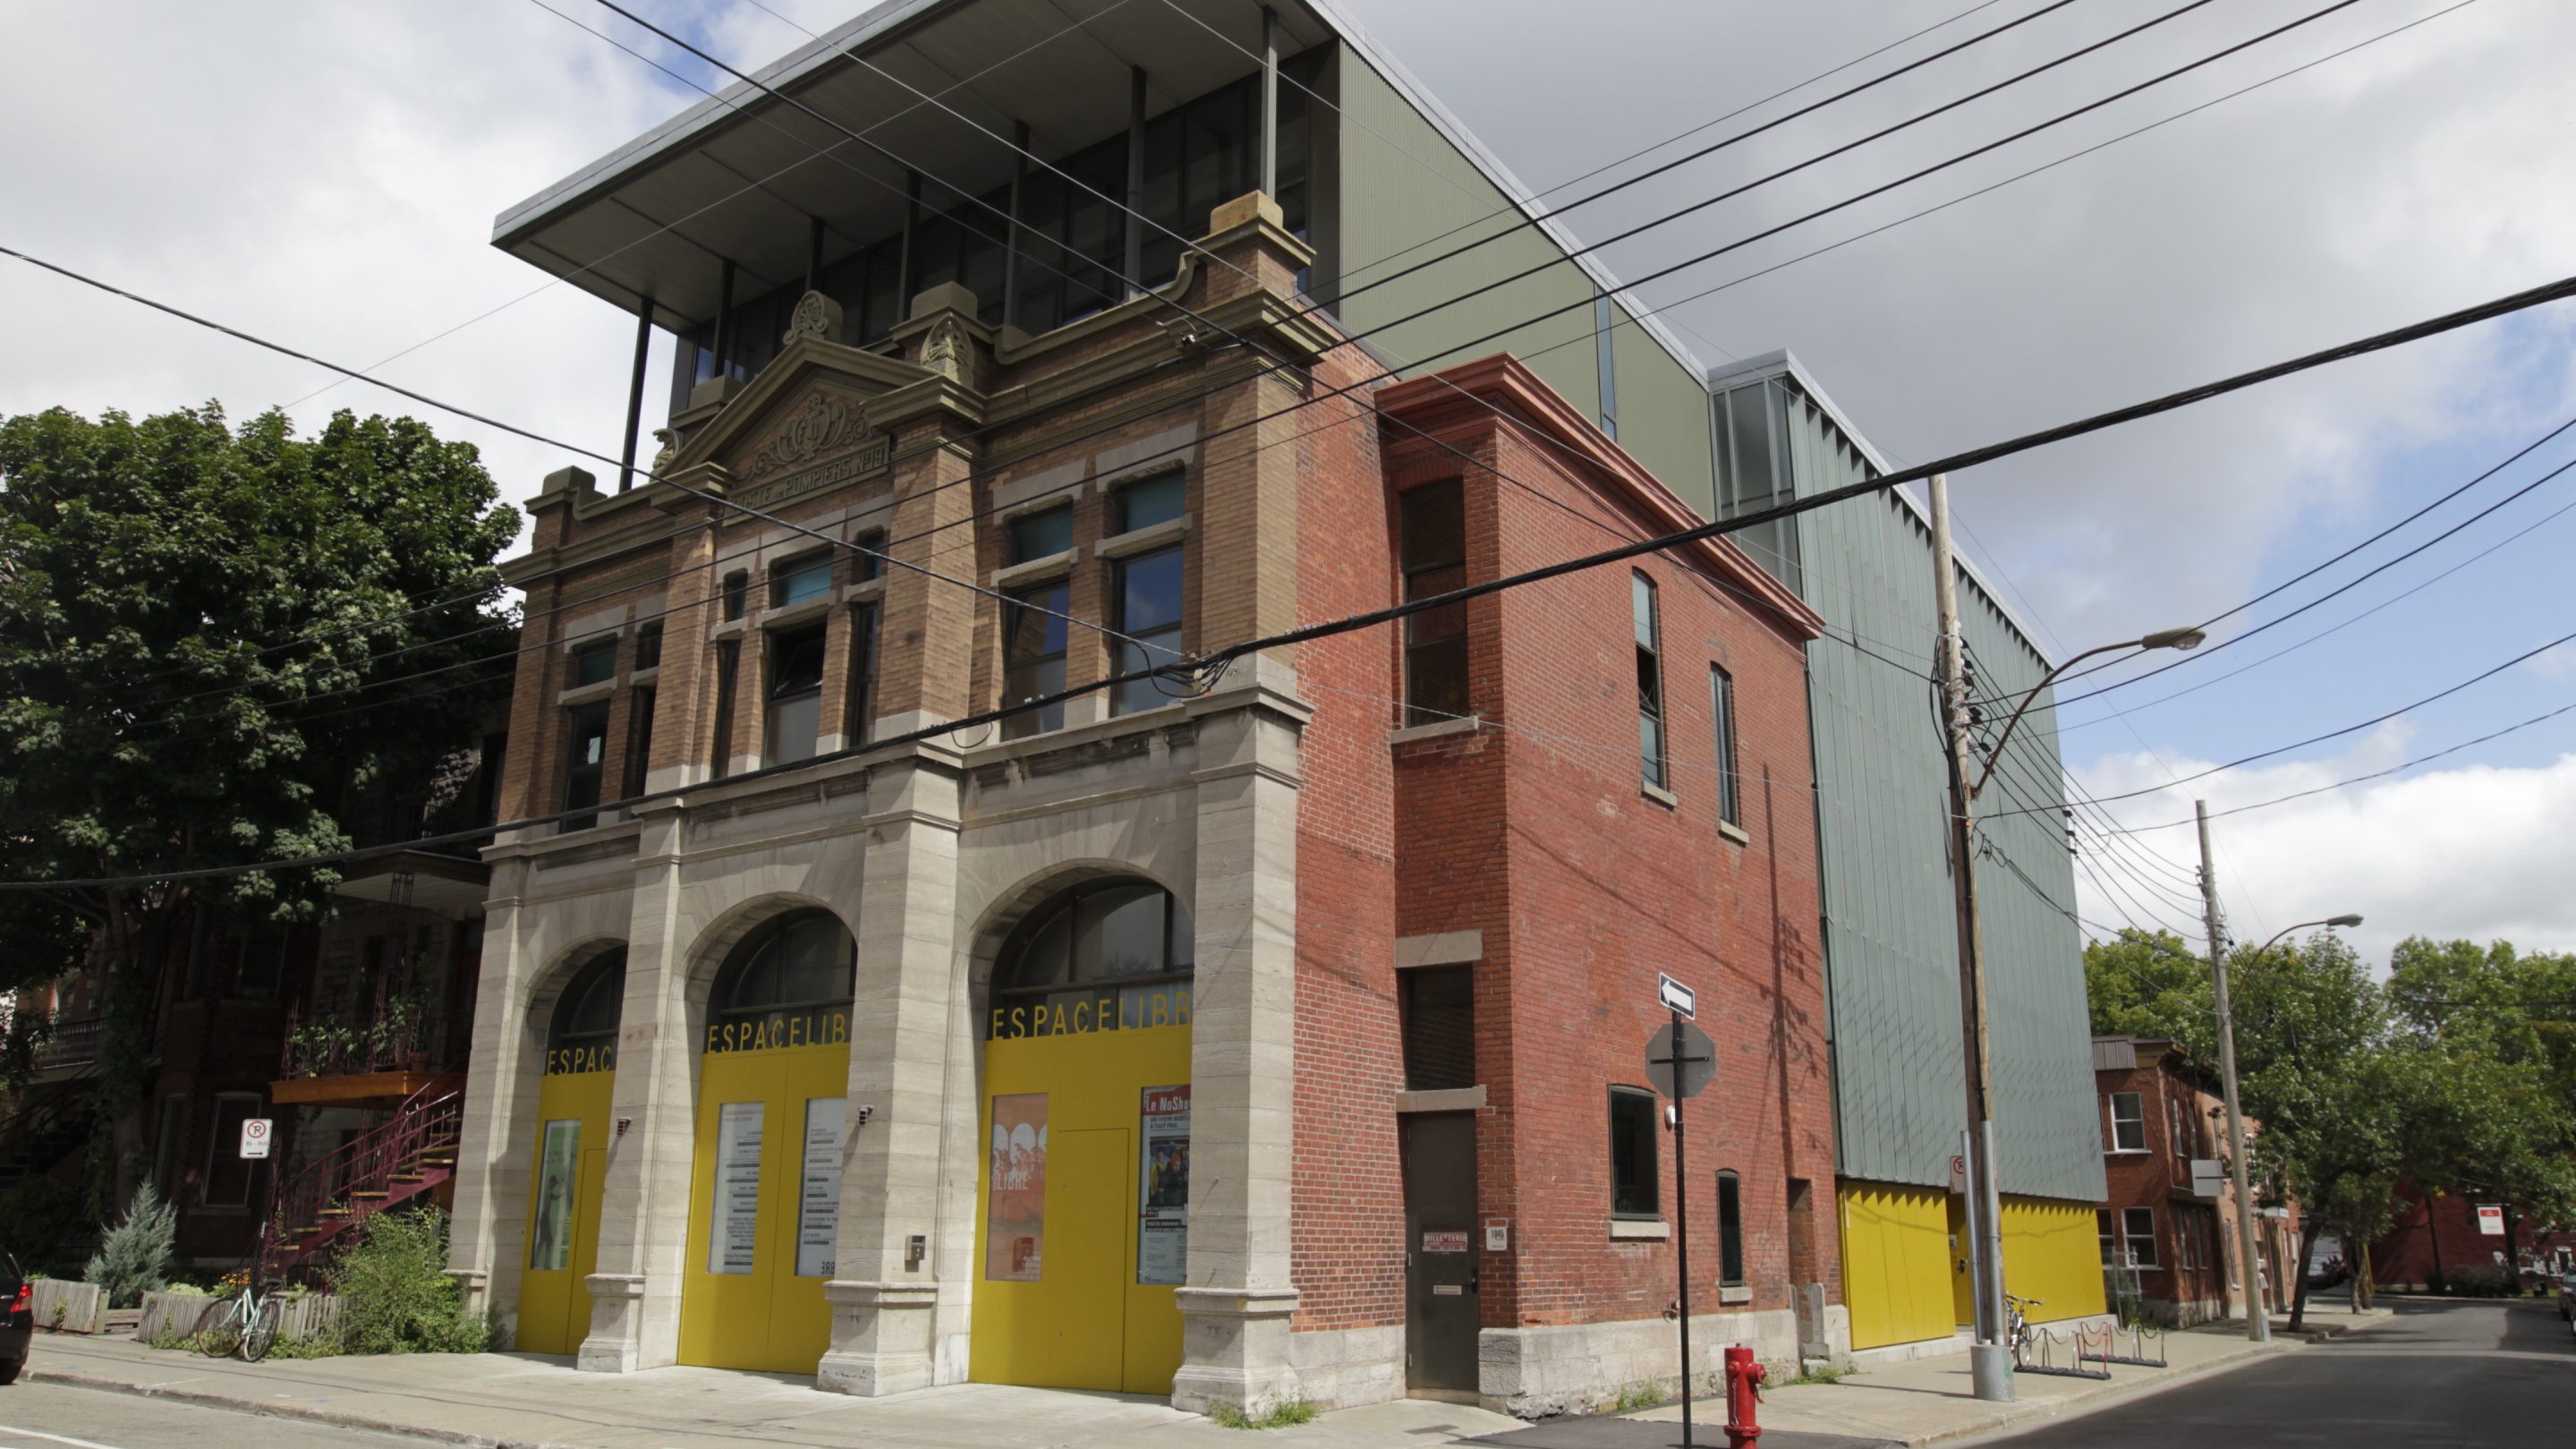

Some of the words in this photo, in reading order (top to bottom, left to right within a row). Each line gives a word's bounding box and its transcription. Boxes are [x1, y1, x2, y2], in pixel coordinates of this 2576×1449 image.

[786, 459, 850, 497] POMPIERS
[1146, 1095, 1157, 1112] Le
[998, 1172, 1029, 1190] LIBRE
